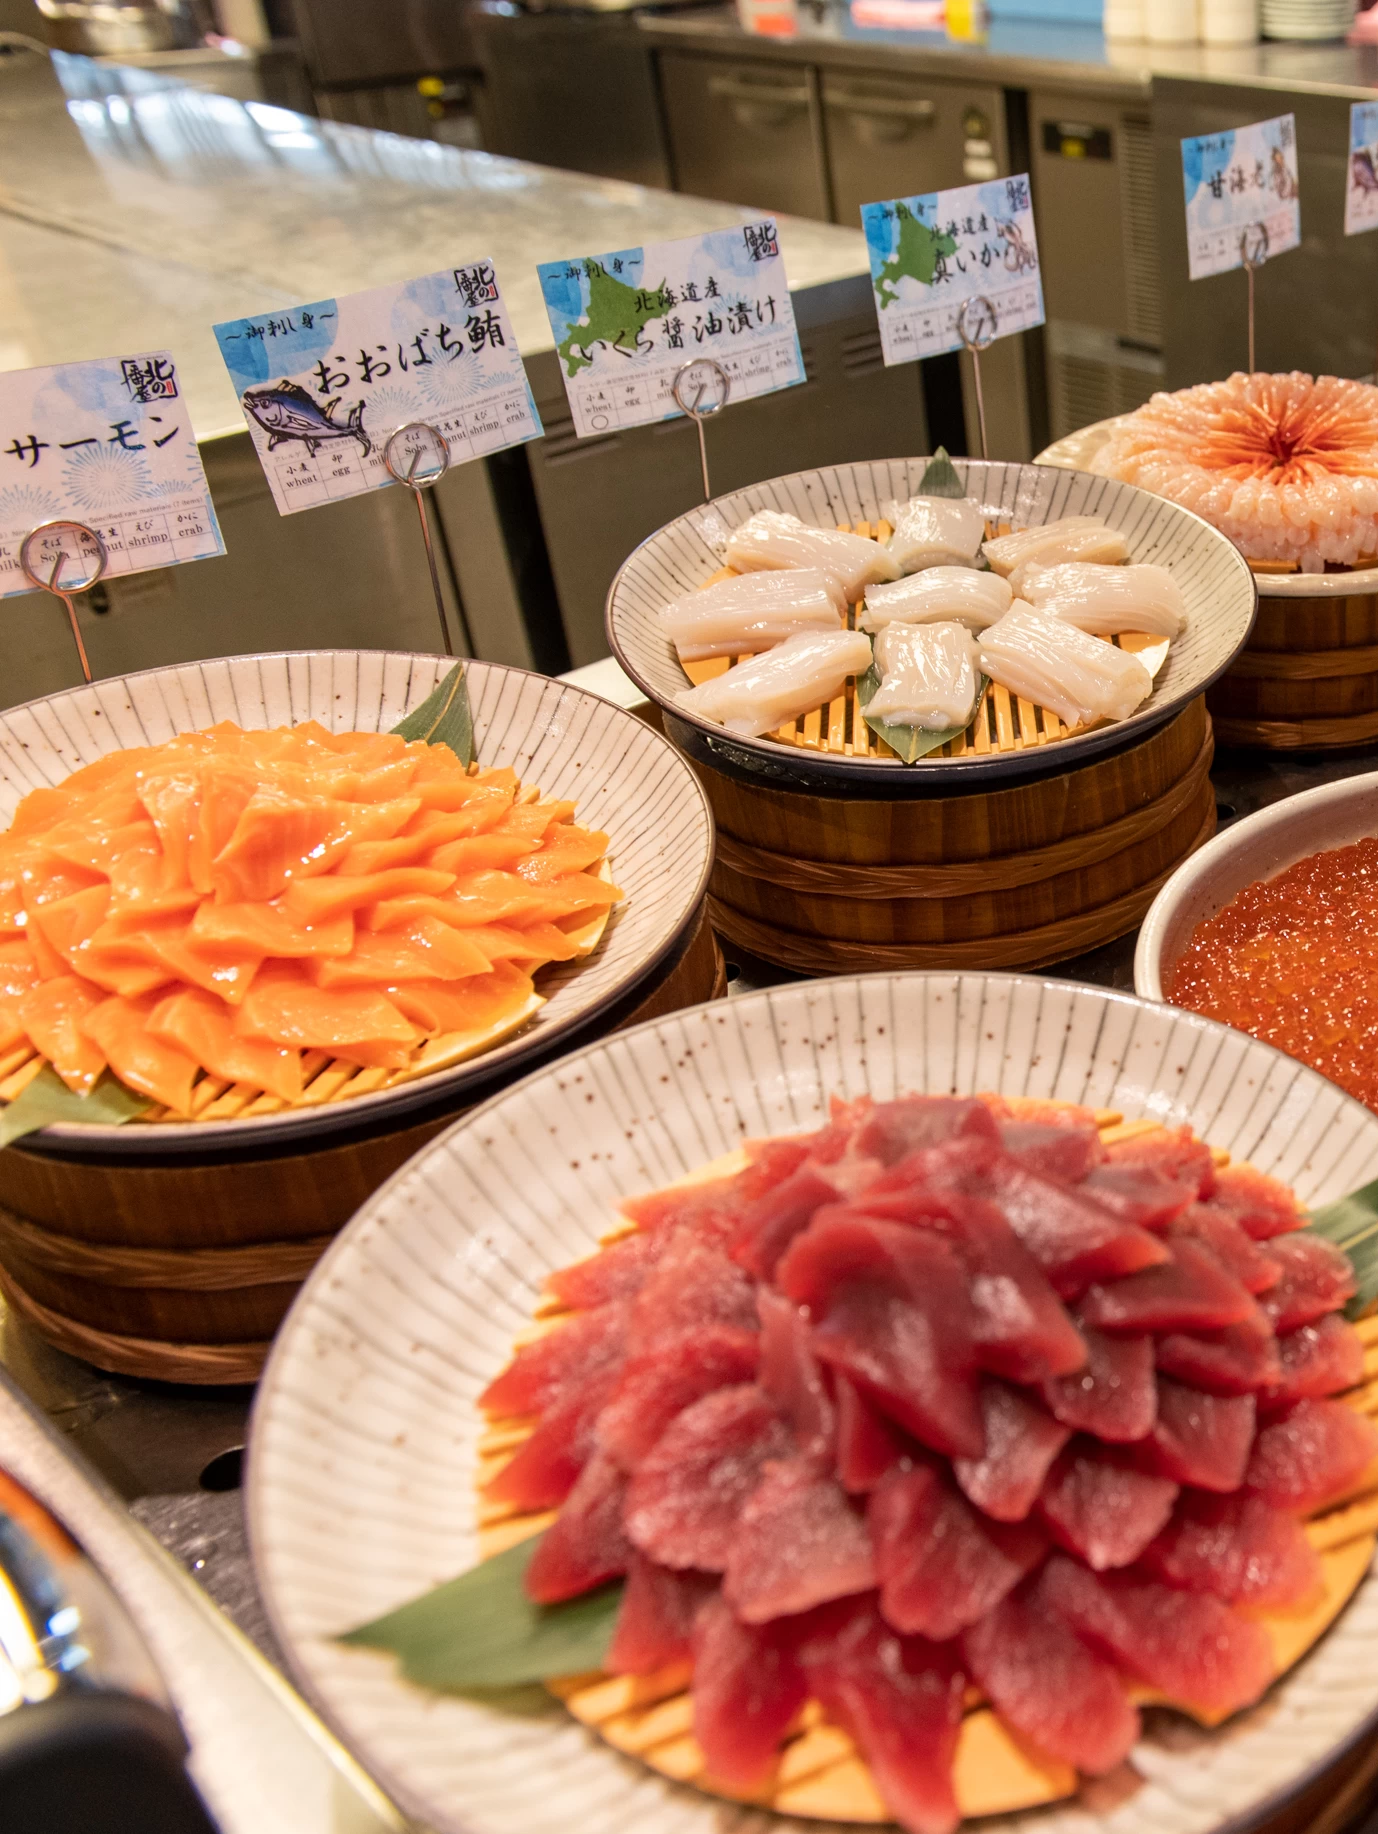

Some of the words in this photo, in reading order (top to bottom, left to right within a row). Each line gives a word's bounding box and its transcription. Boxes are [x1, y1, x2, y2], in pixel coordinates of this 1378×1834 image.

[929, 242, 1001, 285] 真いか
[634, 275, 722, 314] 北海道産
[580, 294, 777, 362] いくら醤油漬け
[313, 309, 506, 395] おおばち鮪
[506, 409, 526, 424] crab
[584, 402, 613, 415] wheat
[469, 420, 500, 436] shrimp
[3, 415, 180, 469] サーモン
[332, 465, 351, 477] egg
[286, 473, 318, 488] wheat
[178, 523, 204, 538] crab
[127, 531, 169, 548] shrimp
